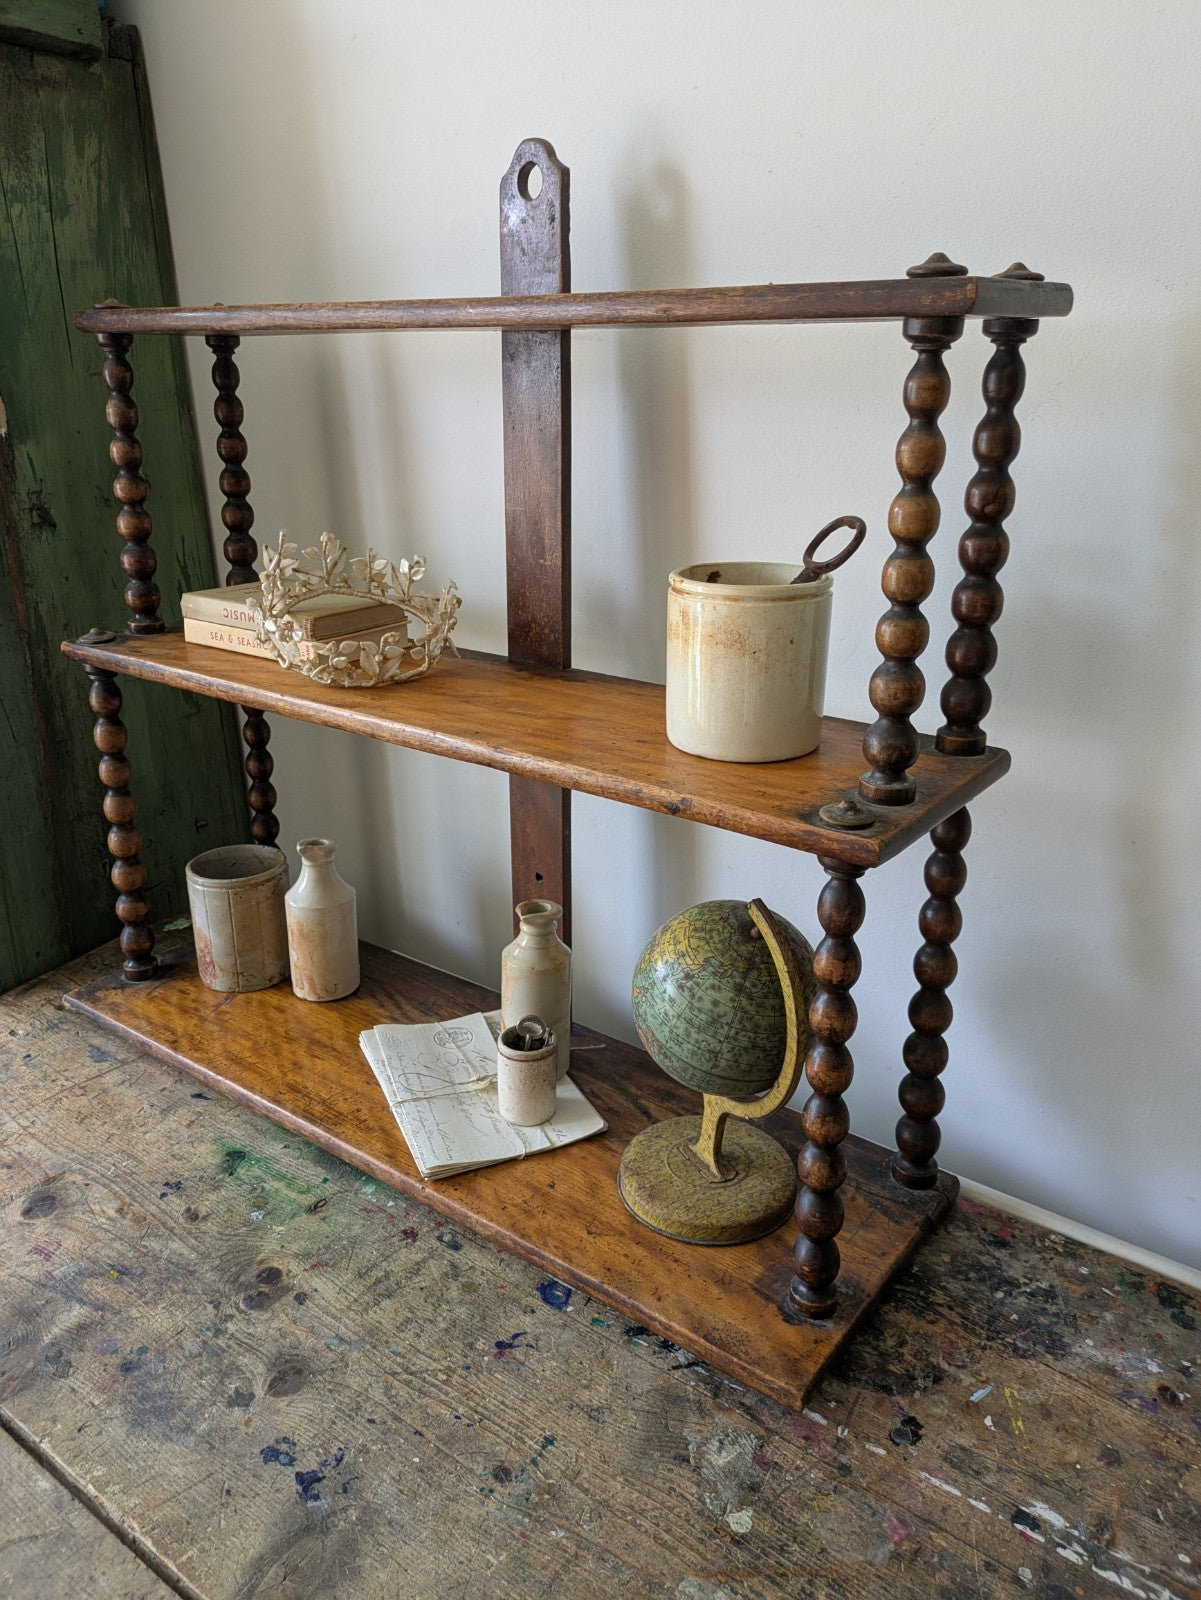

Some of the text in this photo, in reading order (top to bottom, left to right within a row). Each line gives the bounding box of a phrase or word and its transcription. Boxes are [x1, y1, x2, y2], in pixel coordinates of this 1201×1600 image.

[222, 608, 256, 623] MUSIC
[210, 631, 225, 642] SEA
[227, 634, 233, 644] &
